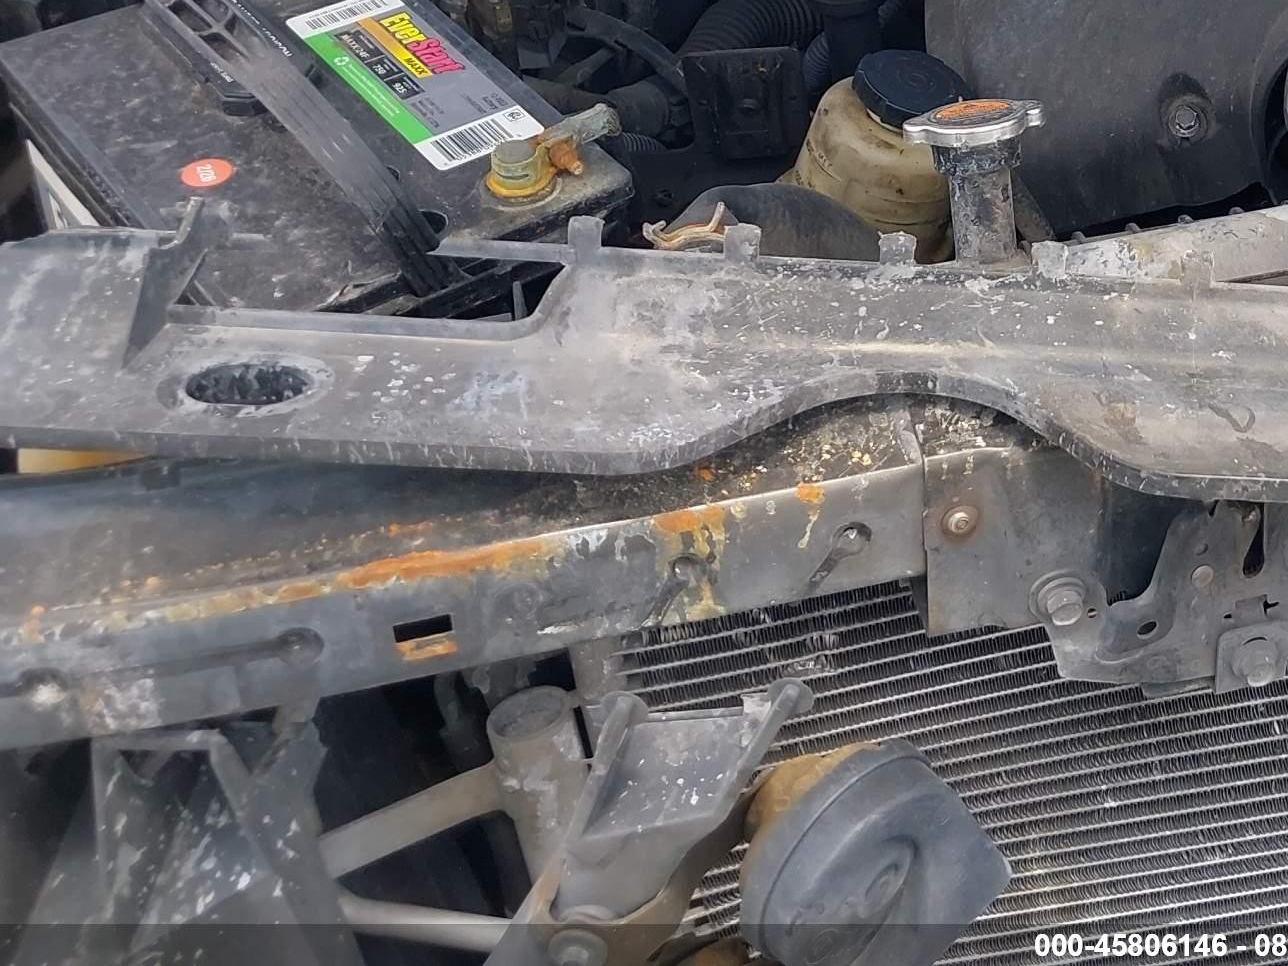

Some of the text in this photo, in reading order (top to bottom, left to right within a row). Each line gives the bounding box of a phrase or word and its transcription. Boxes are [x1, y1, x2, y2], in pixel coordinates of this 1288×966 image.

[377, 11, 466, 75] EverStart
[371, 61, 386, 76] 750
[402, 55, 427, 76] MAXX
